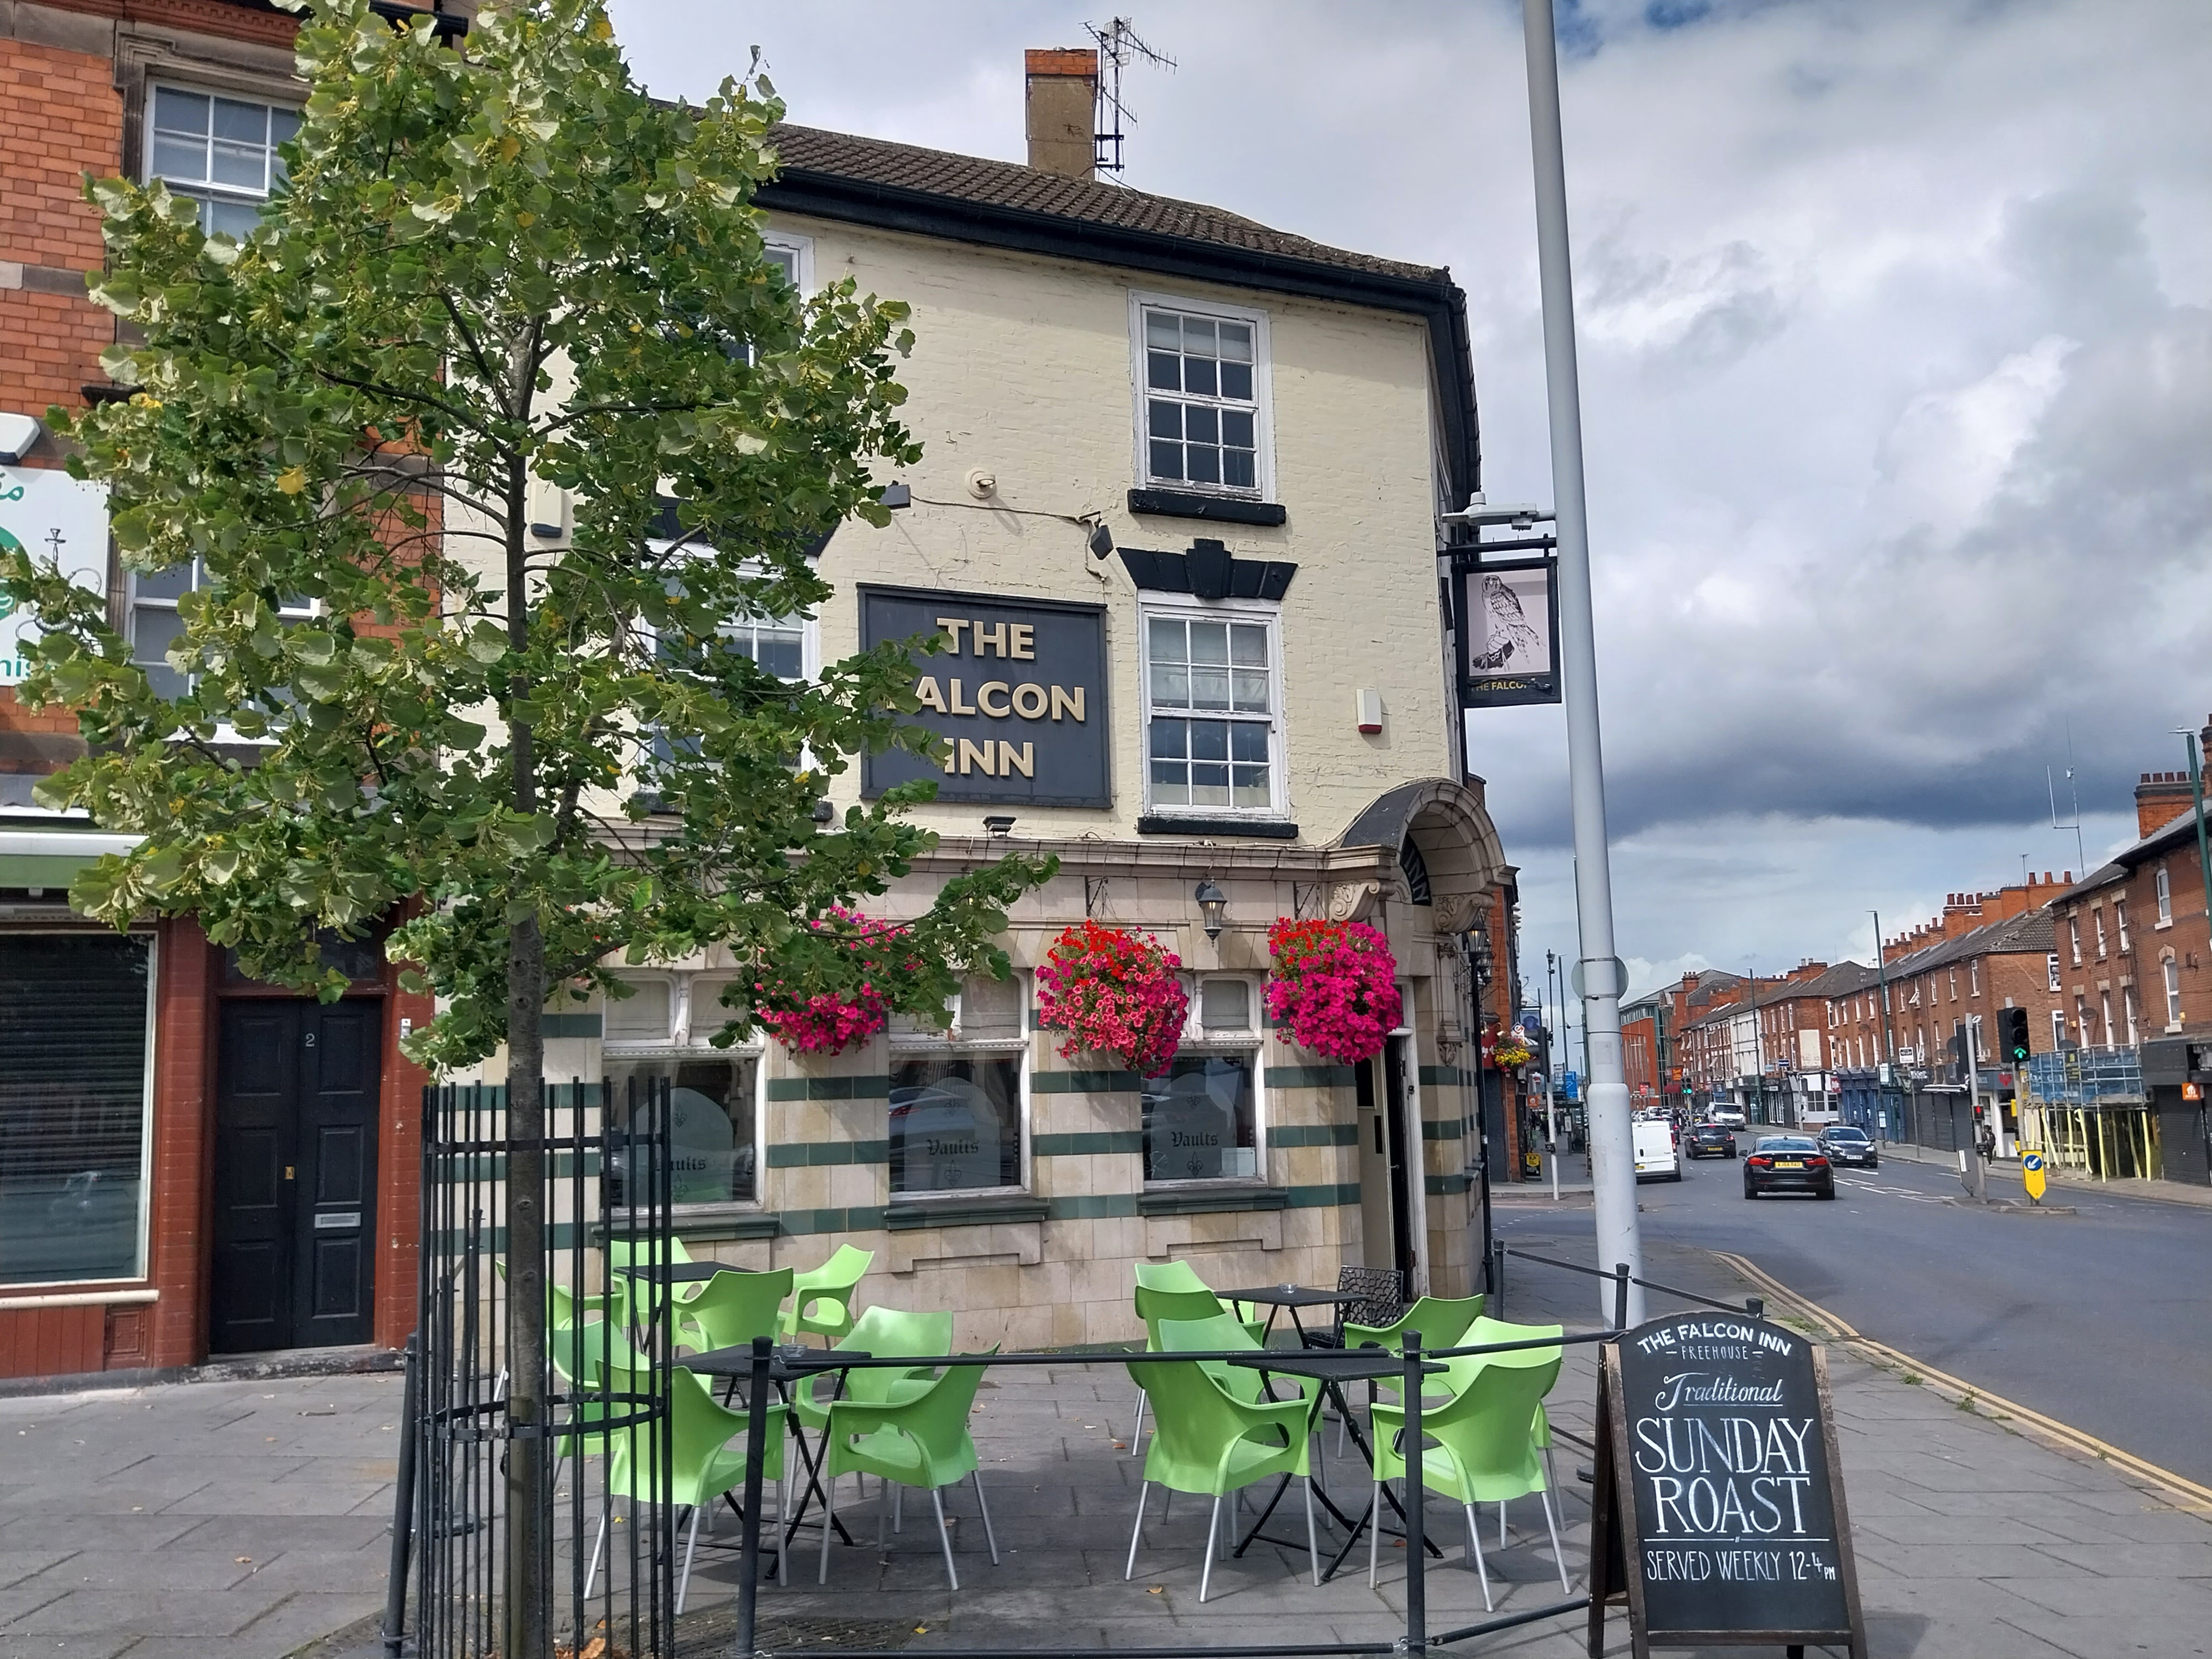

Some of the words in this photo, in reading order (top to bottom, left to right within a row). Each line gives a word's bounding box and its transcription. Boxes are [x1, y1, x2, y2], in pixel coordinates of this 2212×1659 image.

[936, 617, 1035, 660] THE
[886, 676, 1085, 722] ALCON
[1491, 681, 1527, 690] FALCO
[943, 737, 1033, 777] INN
[306, 1033, 315, 1047] 2
[1171, 1131, 1218, 1147] Vaults
[1637, 1328, 1675, 1354] THE
[1677, 1323, 1754, 1342] FALCON
[1758, 1332, 1792, 1356] INN
[1681, 1346, 1748, 1360] FREEHOUSE
[1655, 1372, 1783, 1411] Traditional
[1635, 1417, 1814, 1474] SUNDAY
[1650, 1477, 1810, 1533] ROAST
[1647, 1551, 1711, 1580] SERVED
[1715, 1551, 1780, 1580] WEEKLY
